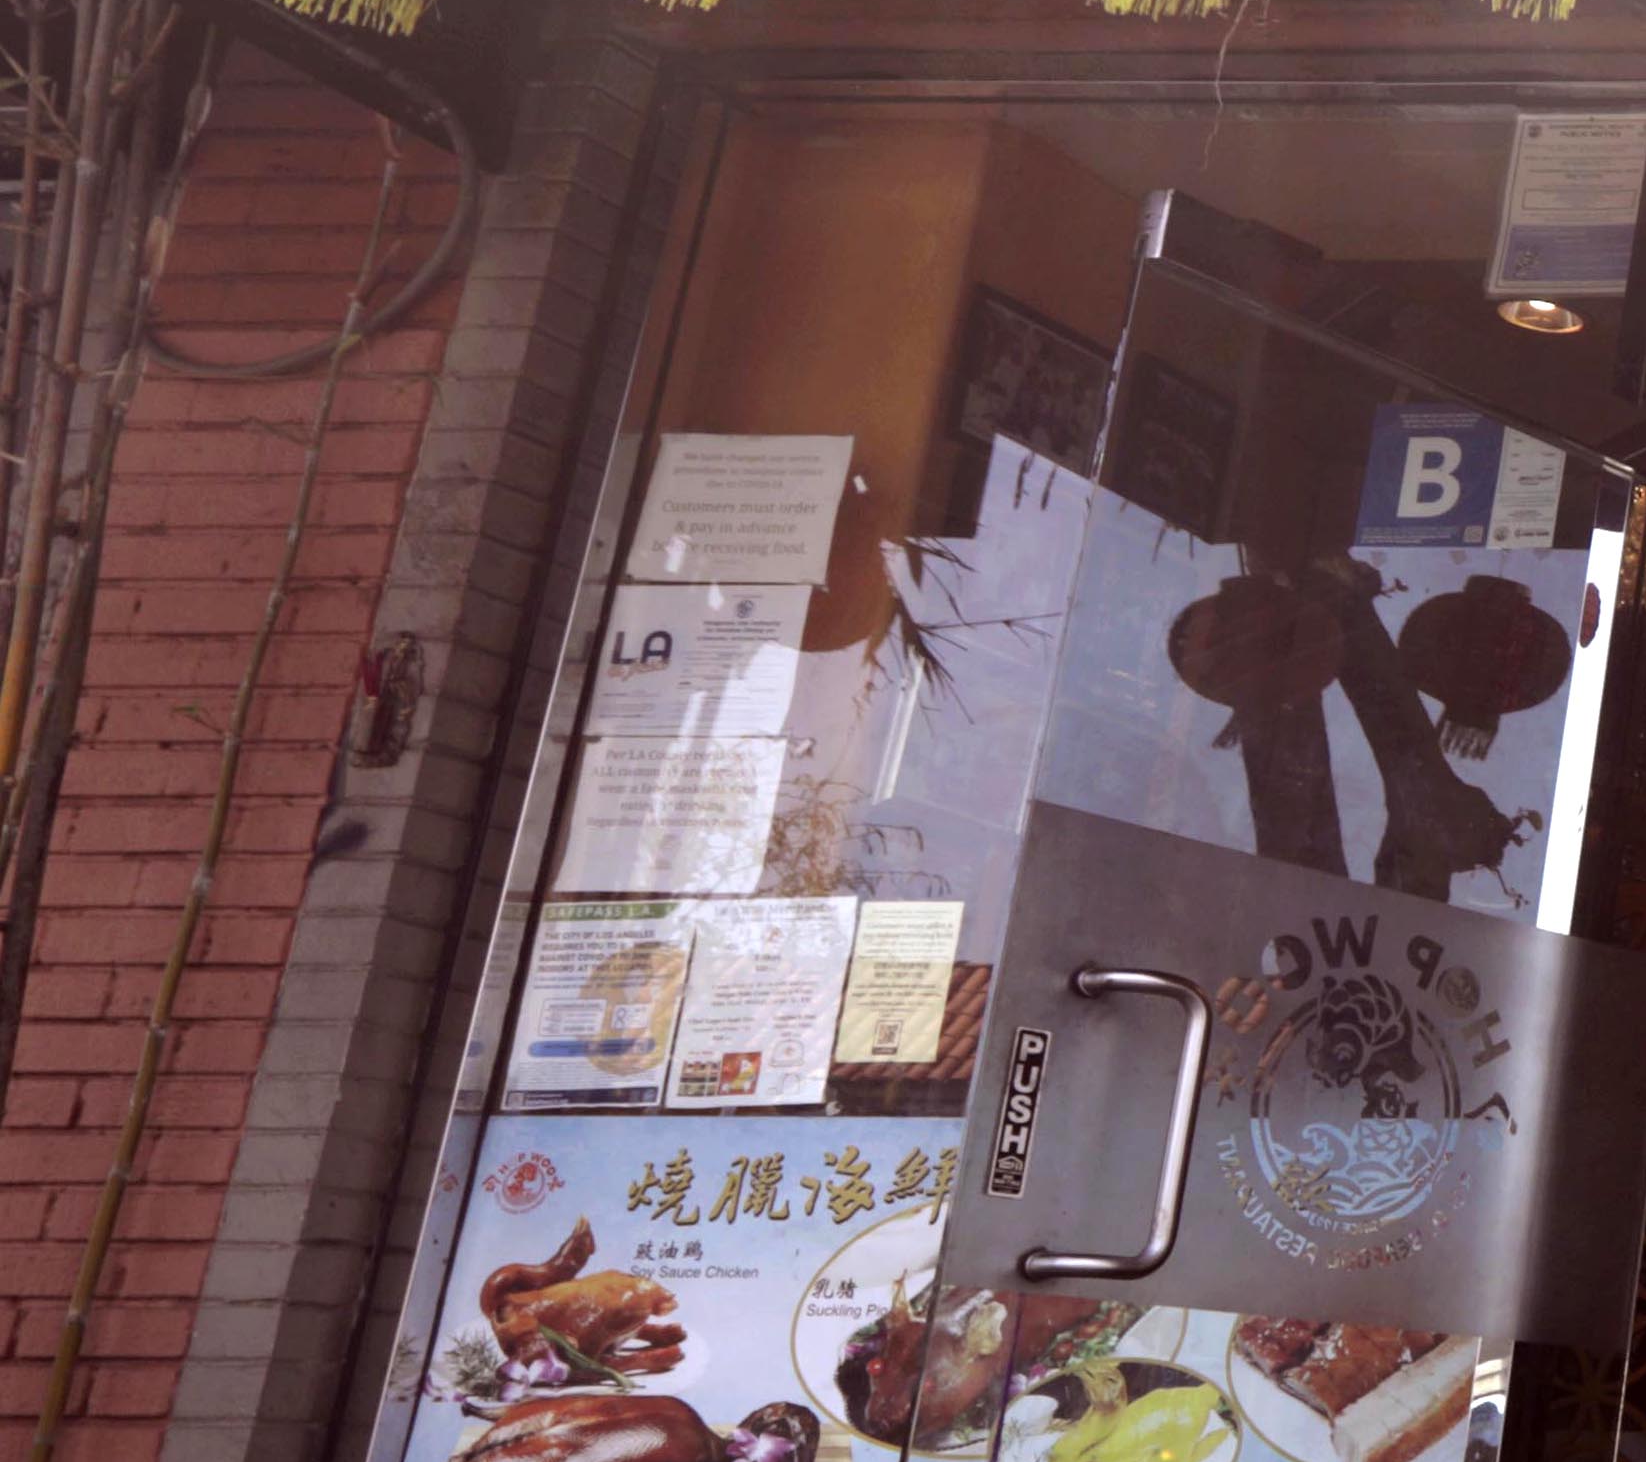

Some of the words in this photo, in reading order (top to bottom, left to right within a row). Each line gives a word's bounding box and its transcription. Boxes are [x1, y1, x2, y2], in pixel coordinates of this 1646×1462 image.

[1396, 436, 1463, 519] B
[662, 500, 735, 513] Customers
[737, 501, 775, 513] must
[778, 500, 818, 513] order
[689, 523, 714, 536] pay
[610, 630, 674, 665] LA
[549, 905, 622, 919] SAFEPASS
[1001, 1035, 1045, 1155] PUSH
[630, 1266, 654, 1280] Soy
[659, 1266, 702, 1279] Sauce
[705, 1266, 759, 1279] Chicken
[806, 1304, 861, 1319] Suckling
